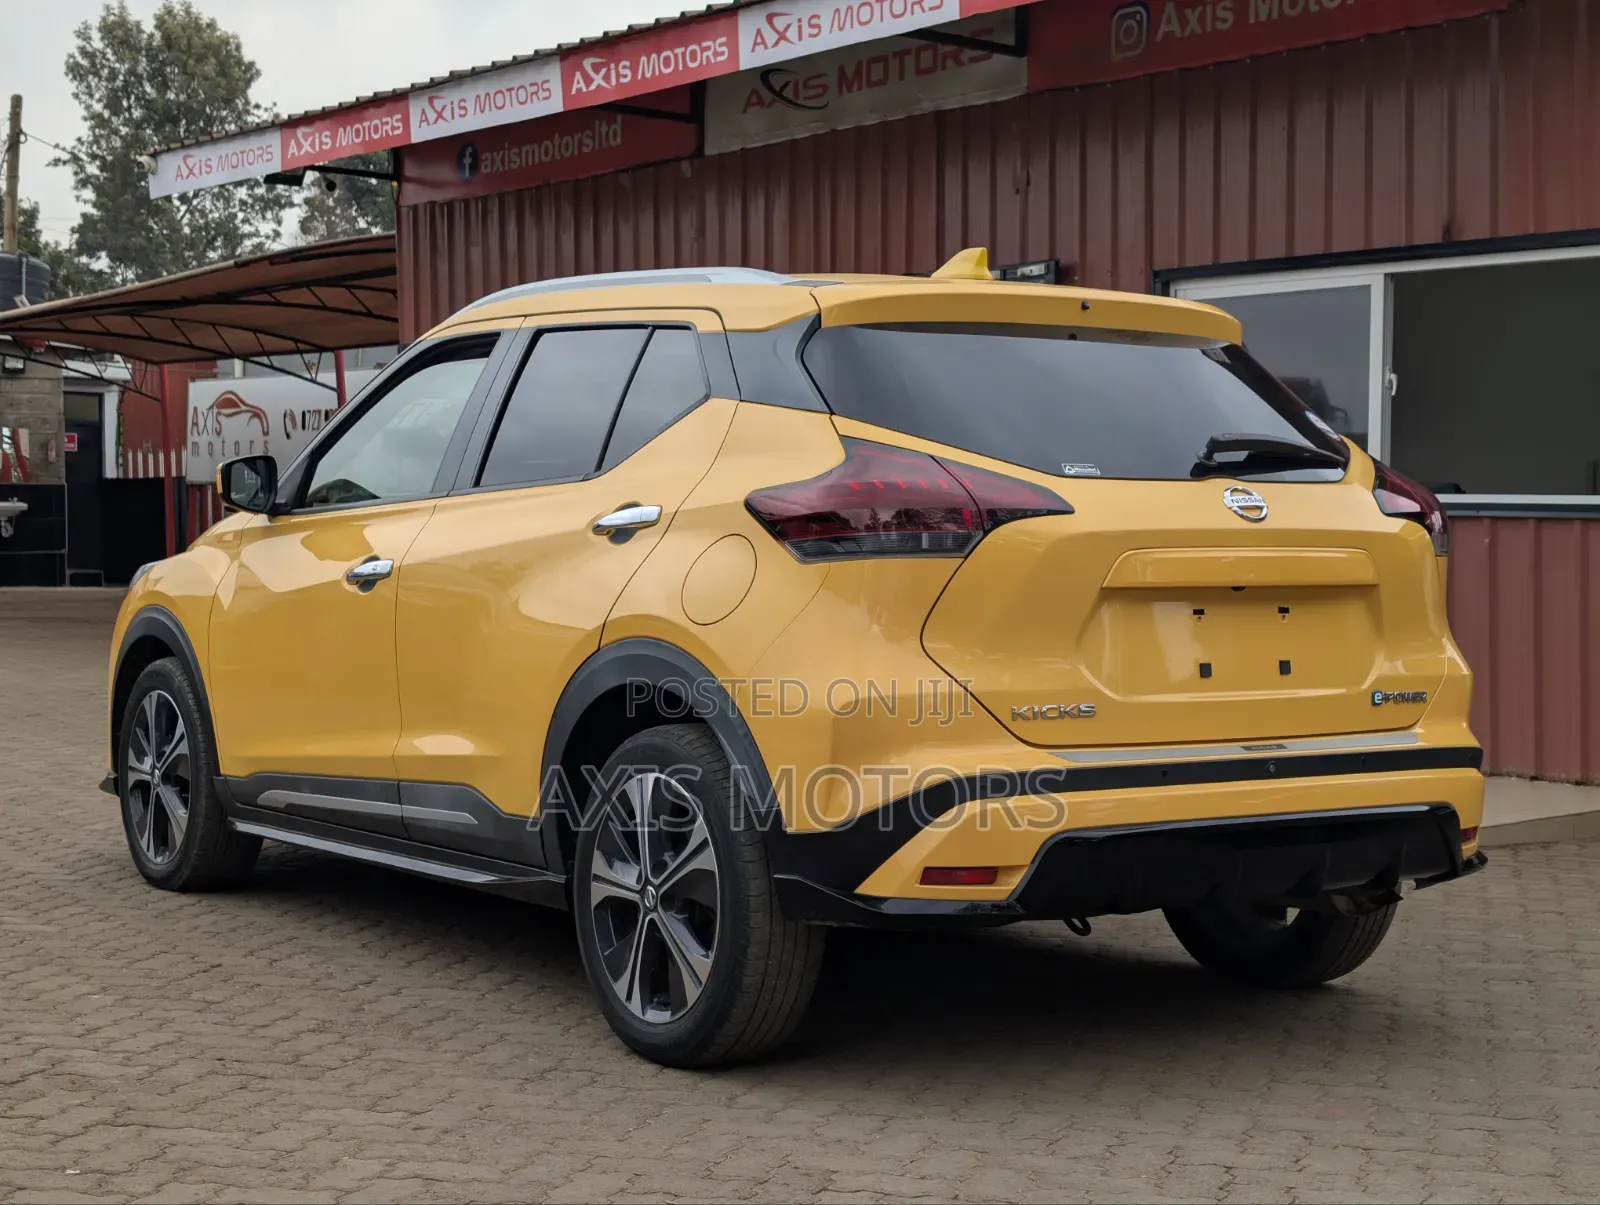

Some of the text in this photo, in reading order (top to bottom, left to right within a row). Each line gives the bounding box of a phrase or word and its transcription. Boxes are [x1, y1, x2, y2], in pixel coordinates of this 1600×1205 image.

[638, 36, 729, 80] MOTORS
[473, 79, 552, 115] MOTORS
[336, 114, 404, 147] MOTORS
[480, 115, 623, 175] axismotorsltd
[216, 145, 274, 172] MOTORS
[191, 439, 269, 458] motors
[1011, 703, 1097, 721] KICKS
